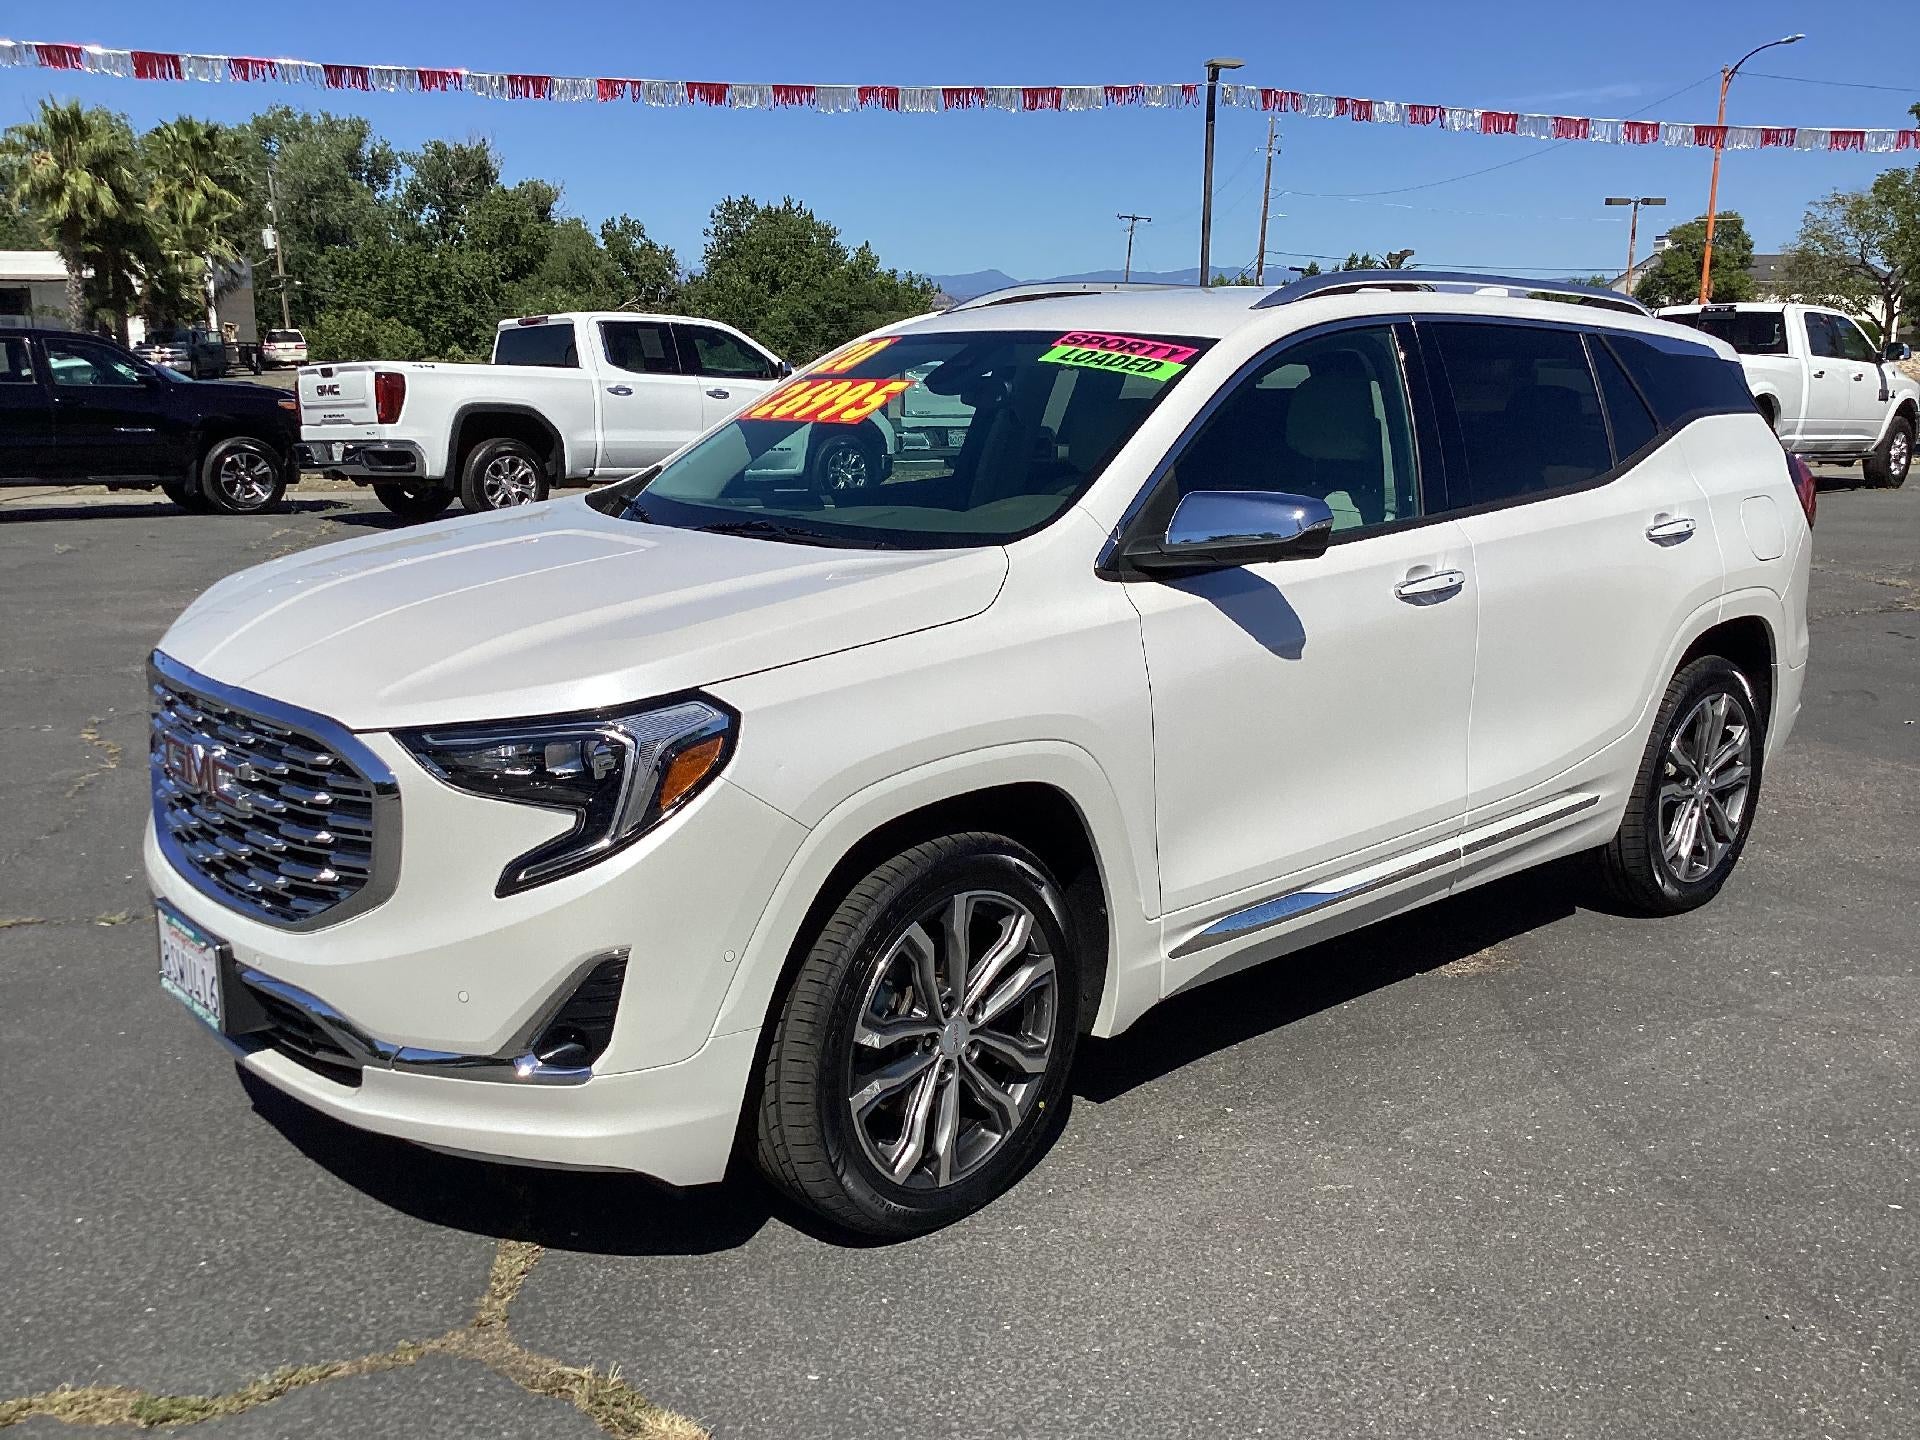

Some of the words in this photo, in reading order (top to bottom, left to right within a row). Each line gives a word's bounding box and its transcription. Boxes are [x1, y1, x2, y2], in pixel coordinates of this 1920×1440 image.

[812, 338, 892, 374] 20
[1058, 348, 1164, 373] LOADED
[1060, 333, 1189, 360] SPORTY
[316, 384, 340, 396] GMC
[750, 380, 910, 420] 26995
[164, 730, 252, 808] GMC
